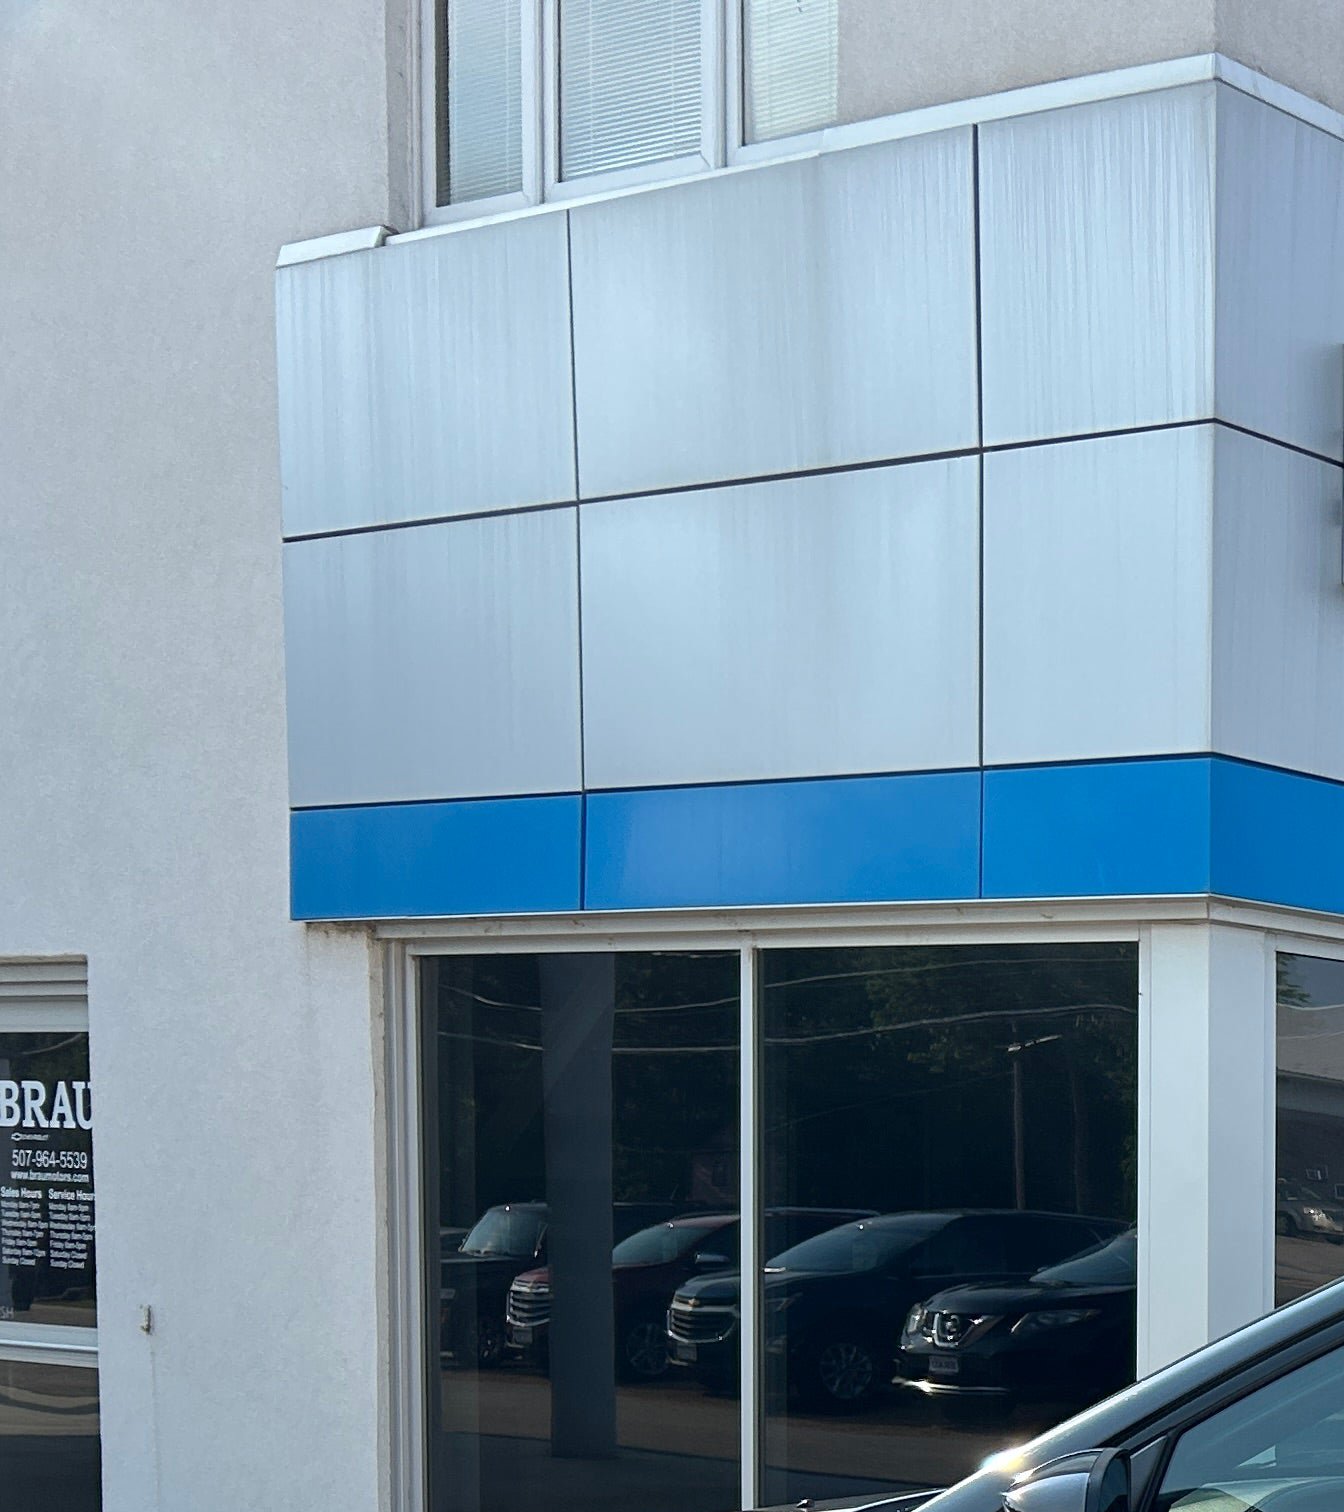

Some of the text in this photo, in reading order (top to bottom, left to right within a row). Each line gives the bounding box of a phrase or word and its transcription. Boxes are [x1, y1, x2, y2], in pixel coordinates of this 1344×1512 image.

[0, 1080, 93, 1130] BRAU
[12, 1149, 88, 1169] 507-964-5539
[1, 1186, 42, 1199] Sales Hours
[48, 1188, 75, 1200] Service
